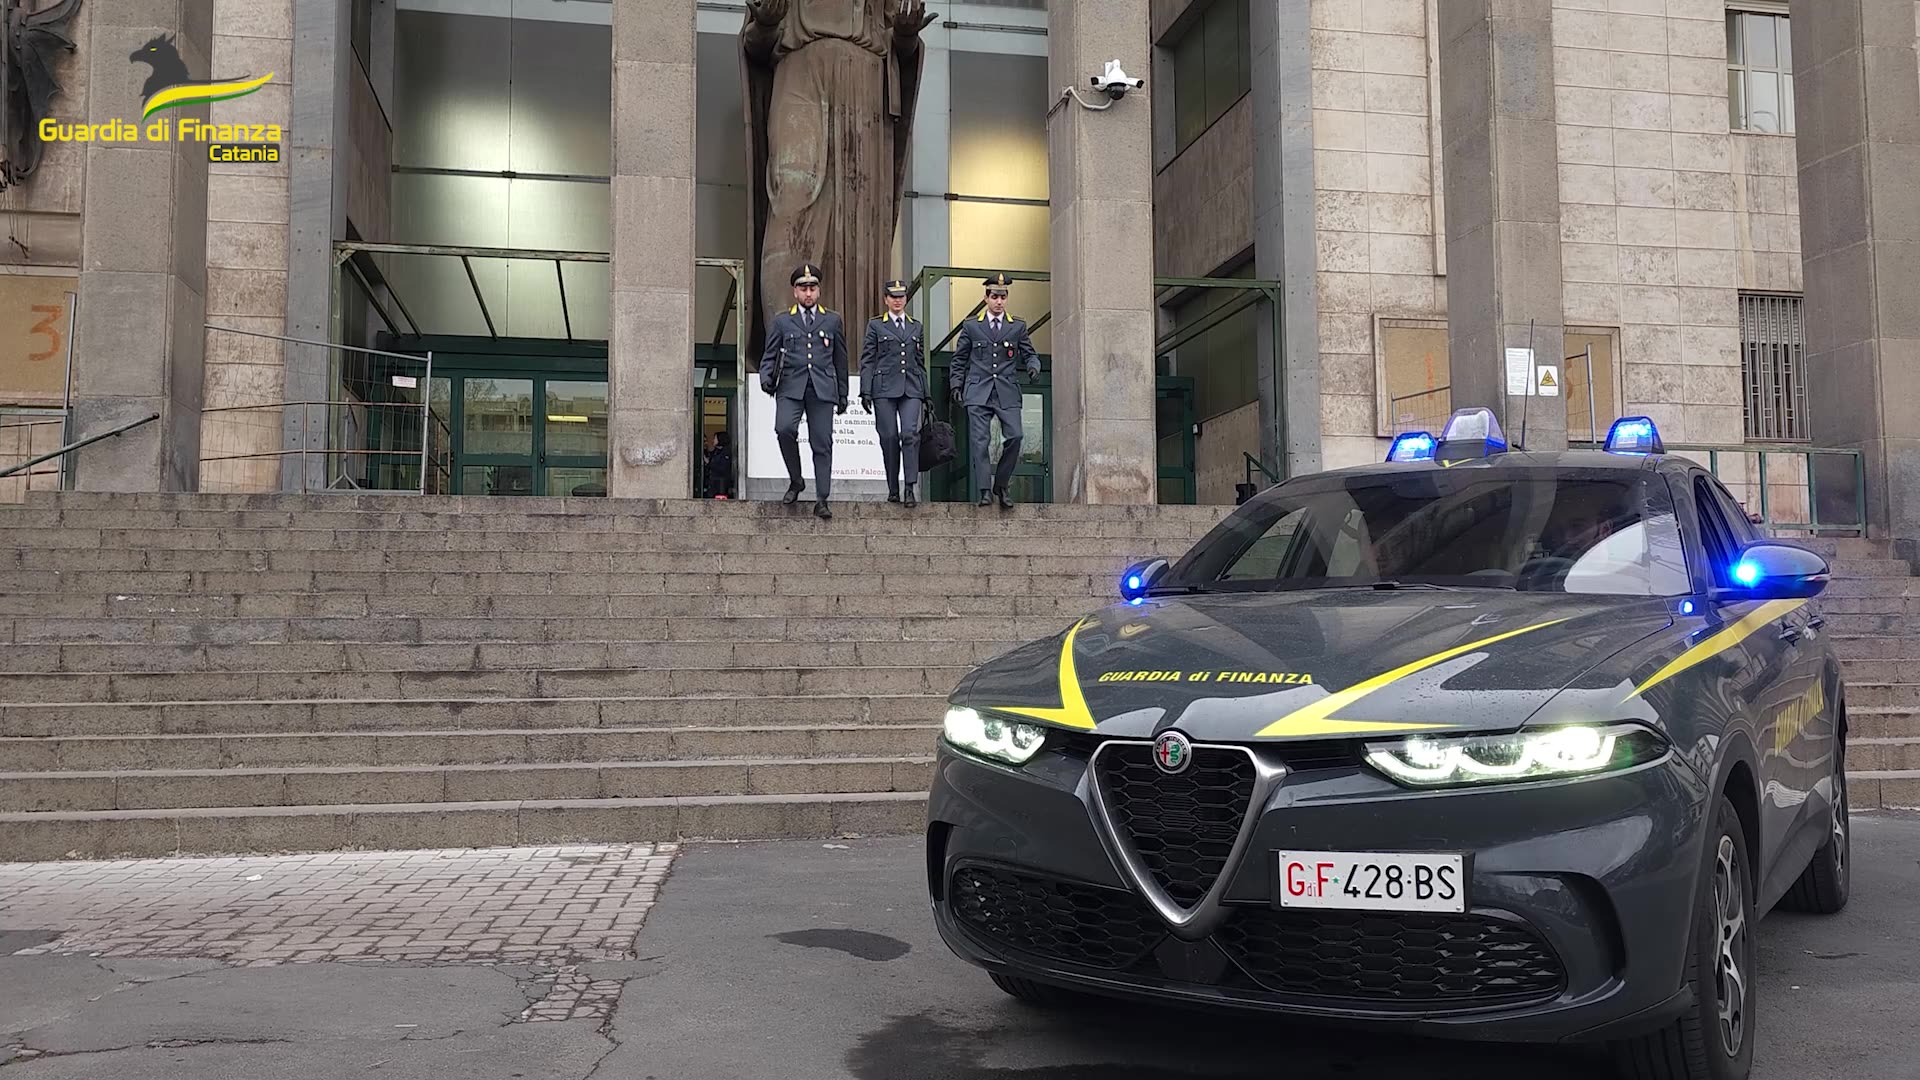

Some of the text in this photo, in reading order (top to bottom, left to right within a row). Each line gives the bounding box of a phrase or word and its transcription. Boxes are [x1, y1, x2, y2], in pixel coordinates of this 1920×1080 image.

[29, 304, 62, 362] 3
[860, 468, 886, 476] Falcon
[1098, 670, 1314, 685] GUARDIA di FINANZA
